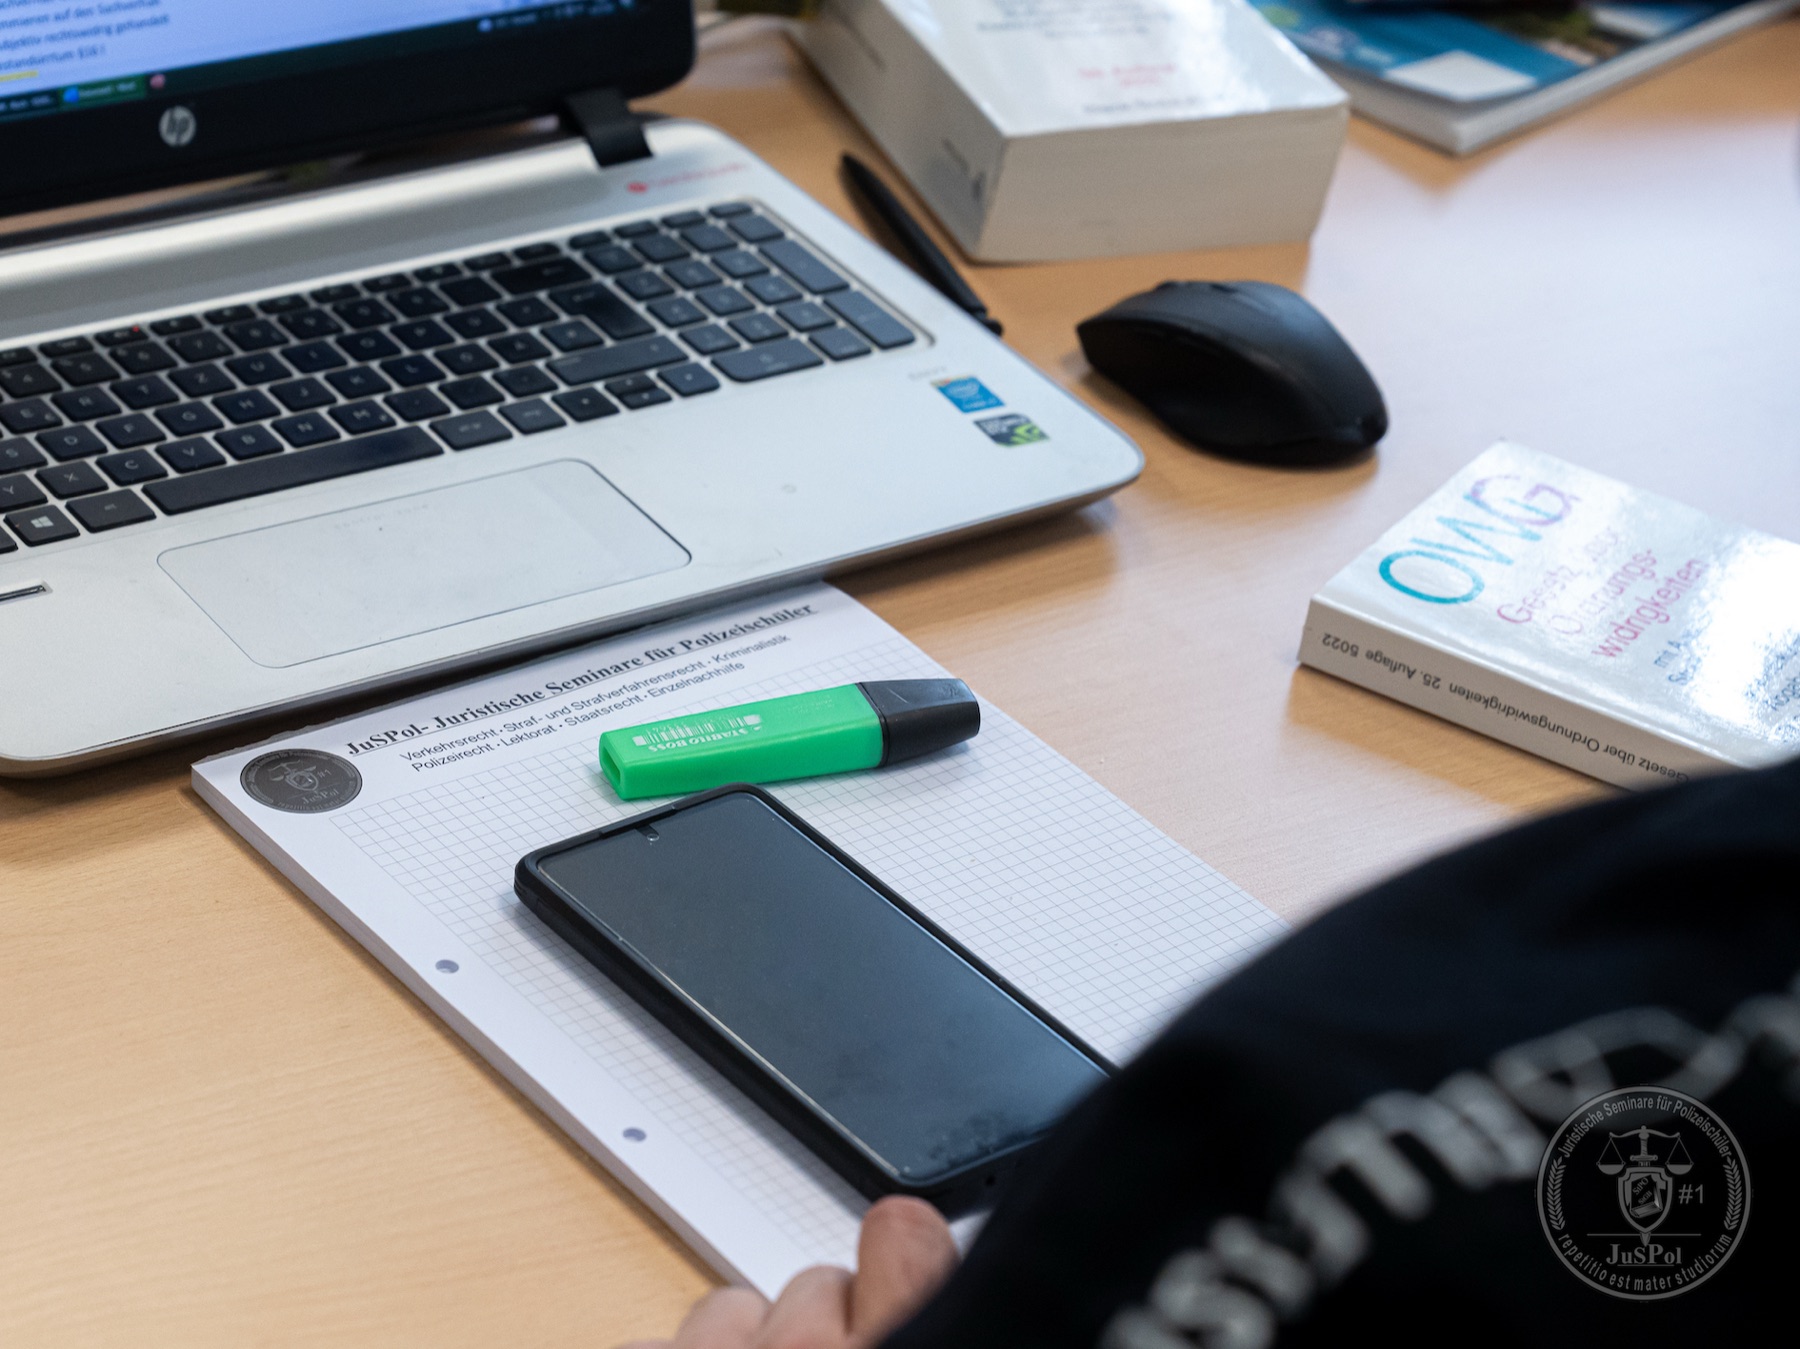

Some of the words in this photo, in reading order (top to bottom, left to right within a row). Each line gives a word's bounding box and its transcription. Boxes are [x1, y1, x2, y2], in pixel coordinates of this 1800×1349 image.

[1322, 633, 1359, 657] 5022
[435, 688, 546, 730] Juristische
[545, 657, 645, 695] Seminare
[644, 645, 676, 668] für
[678, 605, 815, 651] Polizeischüler
[1365, 649, 1418, 679] Auflage
[1420, 670, 1441, 690] 25.
[399, 728, 498, 762] Verkehrsrecht
[503, 716, 543, 733] Straf-
[547, 705, 574, 722] und
[574, 661, 705, 711] Strafverfahrensrecht
[713, 634, 791, 664] Kriminalistik
[411, 743, 495, 772] Polizeirecht
[500, 724, 558, 748] Lektorat
[564, 694, 644, 726] Staatsrecht
[648, 661, 745, 699] Einzelnachhilfe
[1448, 682, 1600, 752] Ordnungswidrigkeiten
[648, 738, 688, 752] BOSS
[1603, 744, 1636, 766] über
